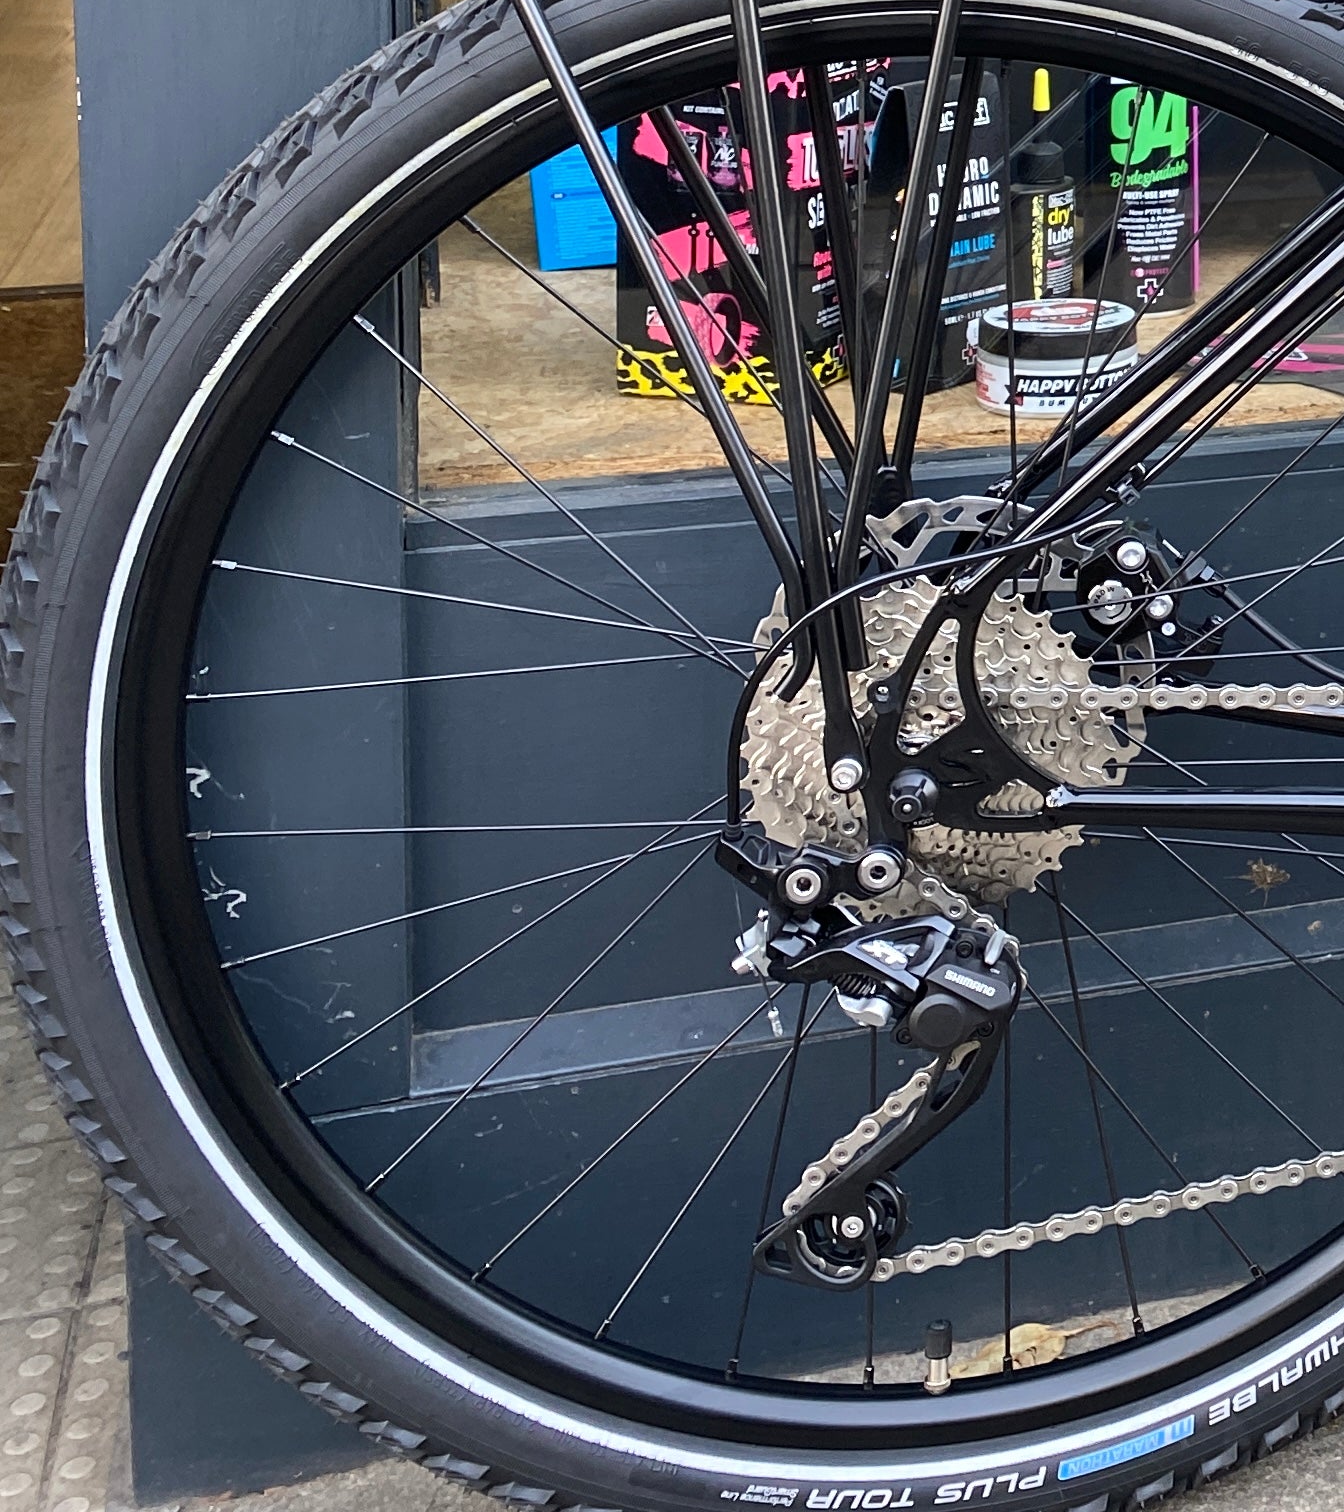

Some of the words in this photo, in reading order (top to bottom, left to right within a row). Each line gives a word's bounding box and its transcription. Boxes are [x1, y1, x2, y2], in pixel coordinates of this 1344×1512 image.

[1110, 87, 1189, 166] 94
[1048, 208, 1070, 226] dry
[1048, 226, 1074, 245] lube
[1017, 378, 1076, 394] HAPPY
[943, 969, 997, 998] SHIMANO
[1066, 1432, 1162, 1476] MARATHON
[805, 1483, 916, 1511] TOUR
[932, 1464, 1047, 1507] PLUS
